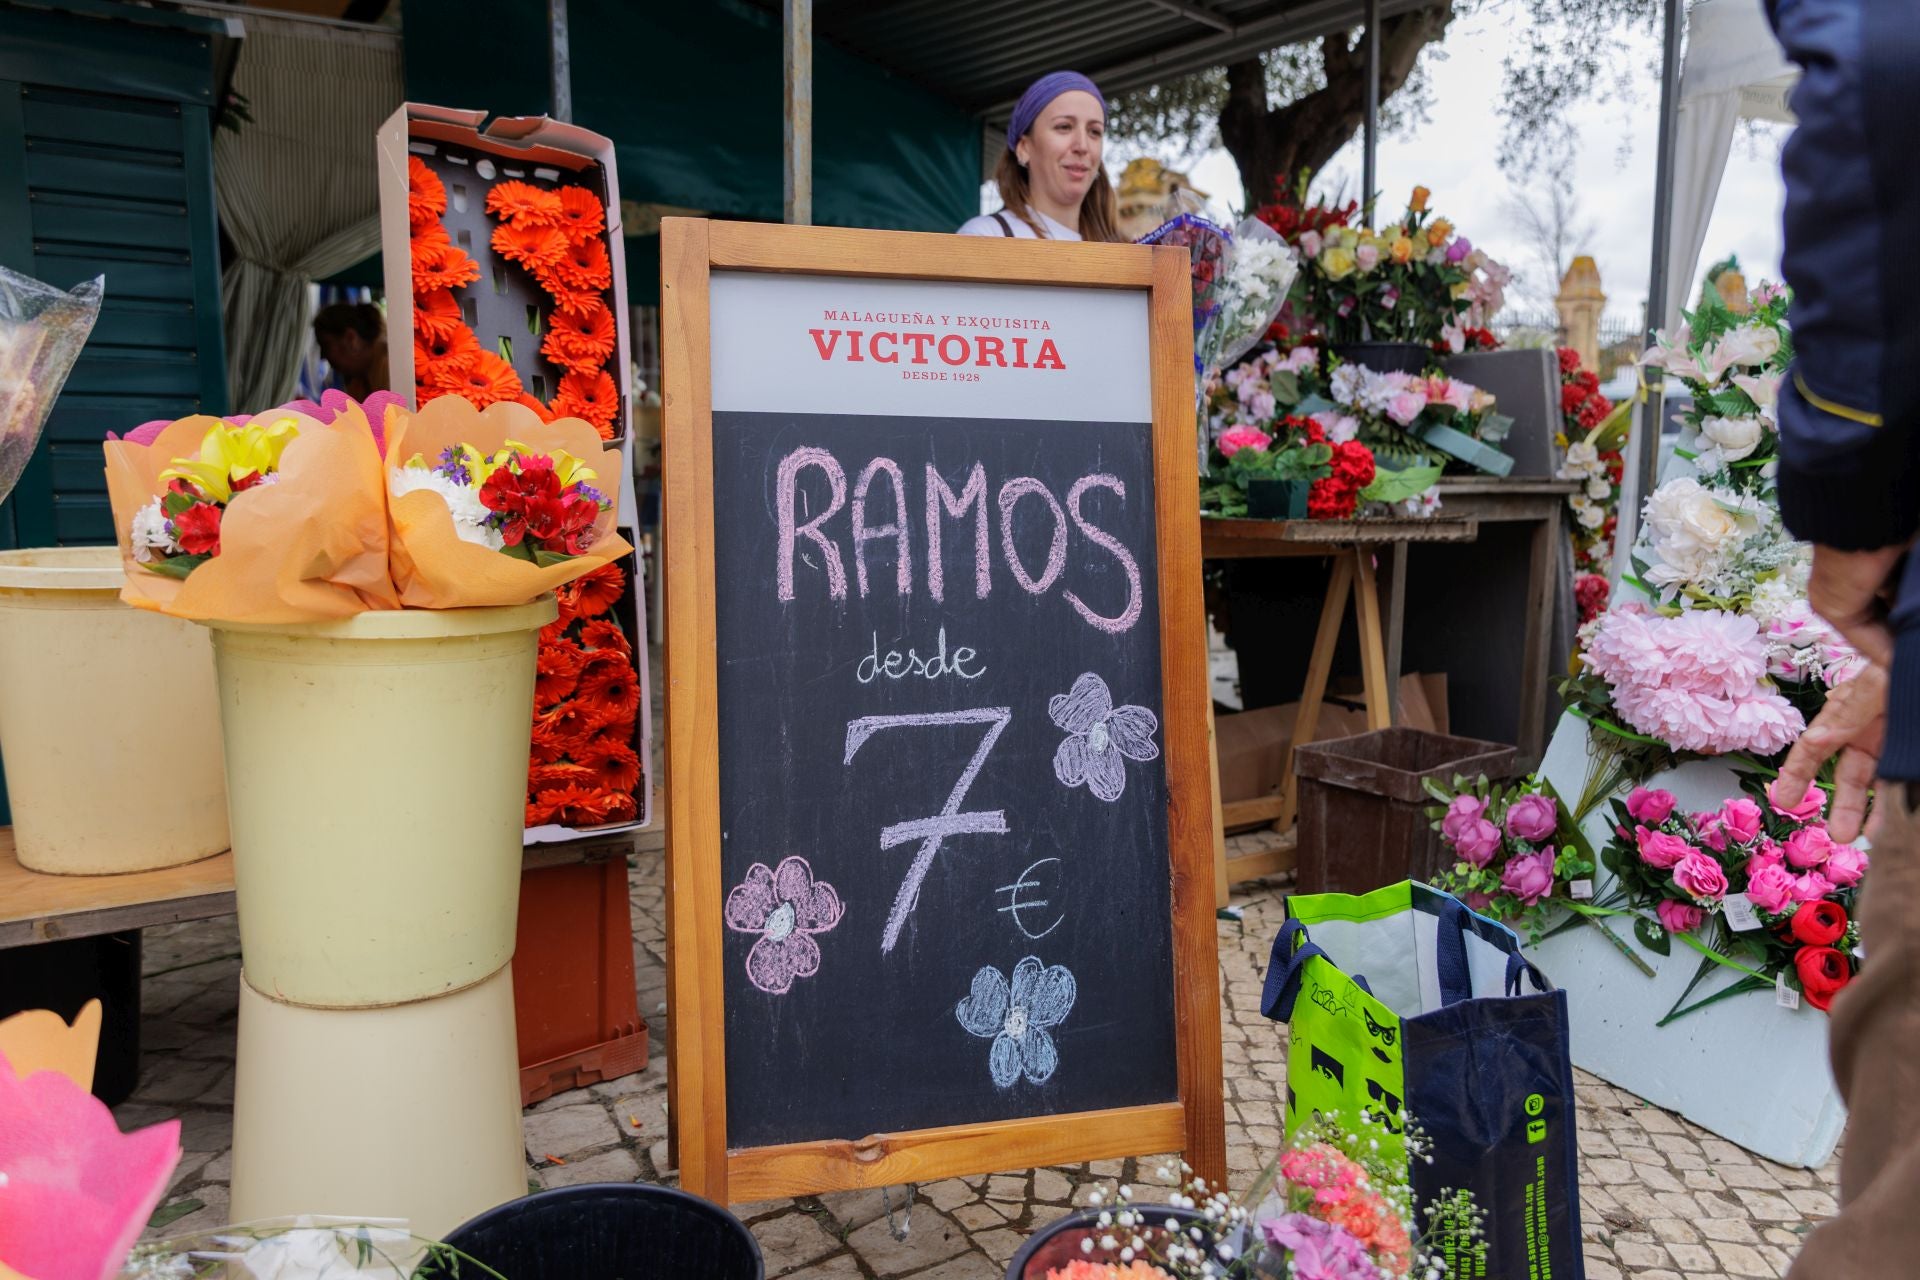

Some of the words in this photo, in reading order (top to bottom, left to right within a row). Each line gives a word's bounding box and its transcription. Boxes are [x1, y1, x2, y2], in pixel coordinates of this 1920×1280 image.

[823, 310, 936, 325] MALAGUEÑA
[940, 315, 951, 326] Y
[957, 316, 1051, 330] EXQUISITA
[808, 328, 1066, 370] VICTORIA
[902, 371, 948, 381] DESDE
[952, 373, 981, 382] 1928
[776, 445, 1142, 633] RAMOS
[857, 626, 987, 684] desde
[843, 706, 1012, 954] 7
